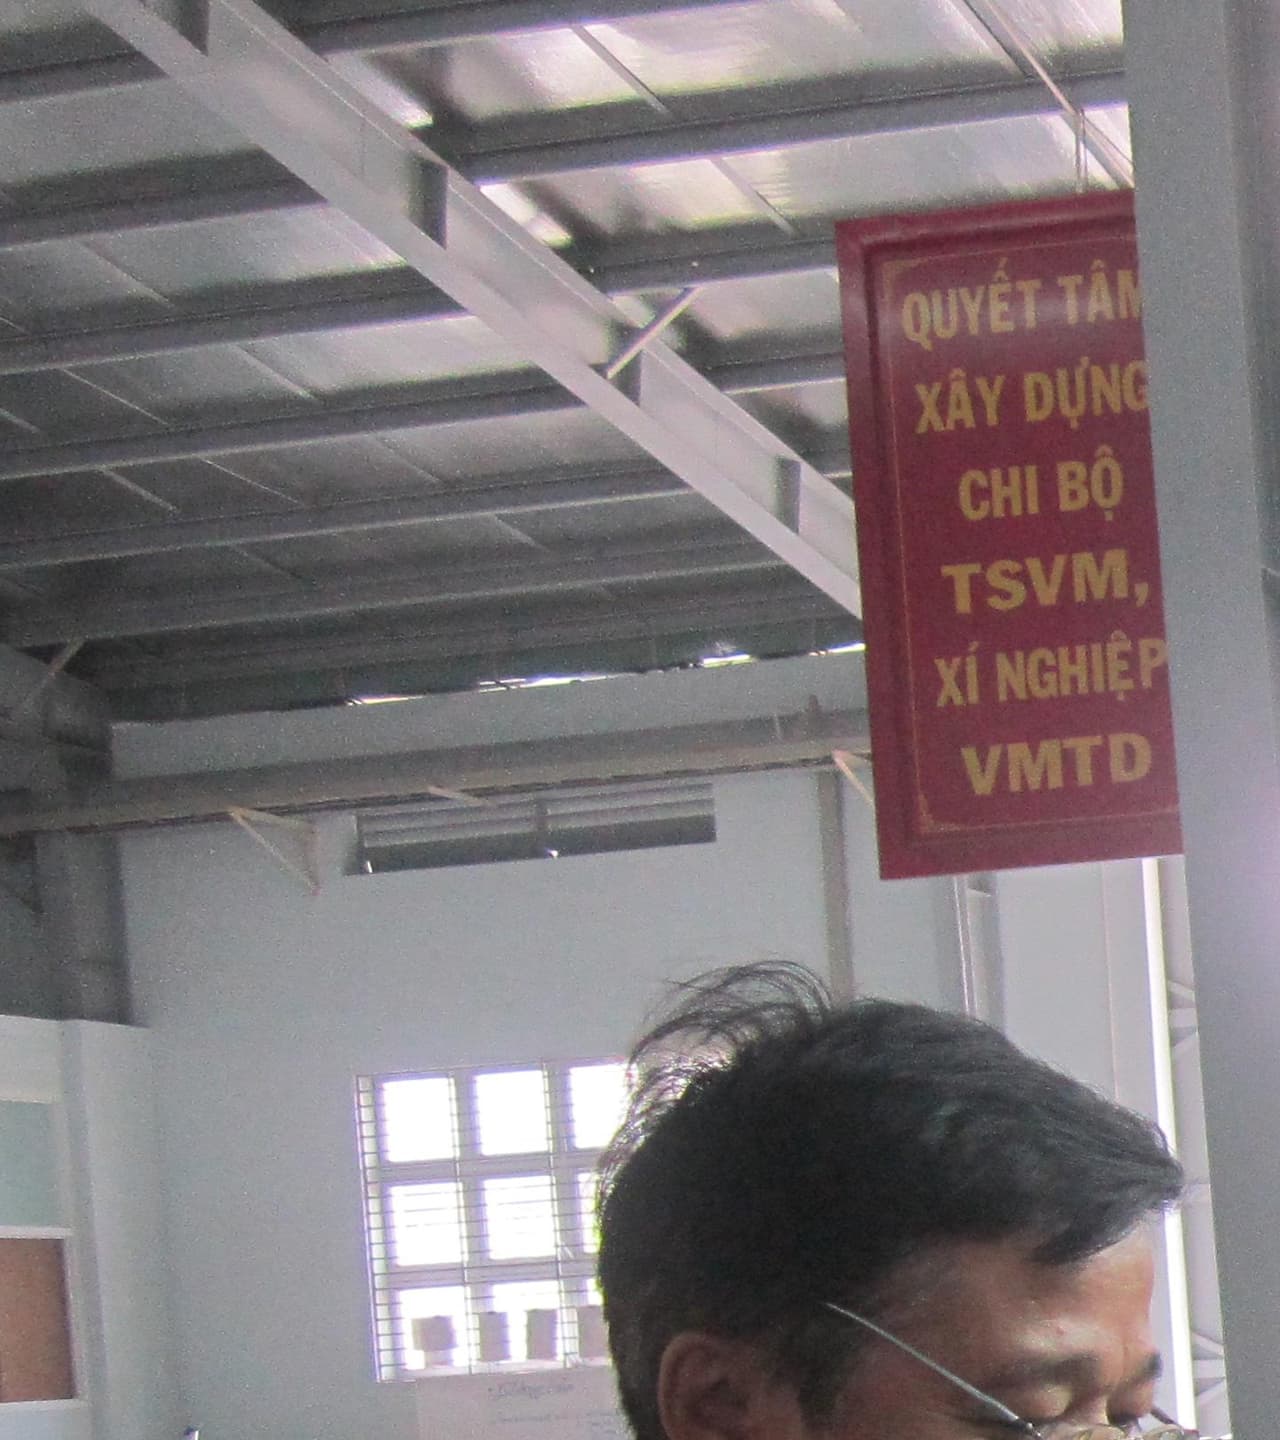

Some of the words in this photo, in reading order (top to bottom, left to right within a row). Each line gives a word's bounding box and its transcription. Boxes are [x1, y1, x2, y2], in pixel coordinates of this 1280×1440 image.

[902, 258, 1042, 351] QUYẾT
[915, 367, 1005, 434] XÂY
[1024, 356, 1150, 429] DỰNG
[958, 464, 1041, 522] CHI
[1057, 444, 1124, 521] BỘ
[941, 549, 1149, 615] TSVM,
[934, 641, 981, 708] XÍ
[996, 630, 1169, 702] NGHIỆP
[960, 732, 1152, 796] VMTD
